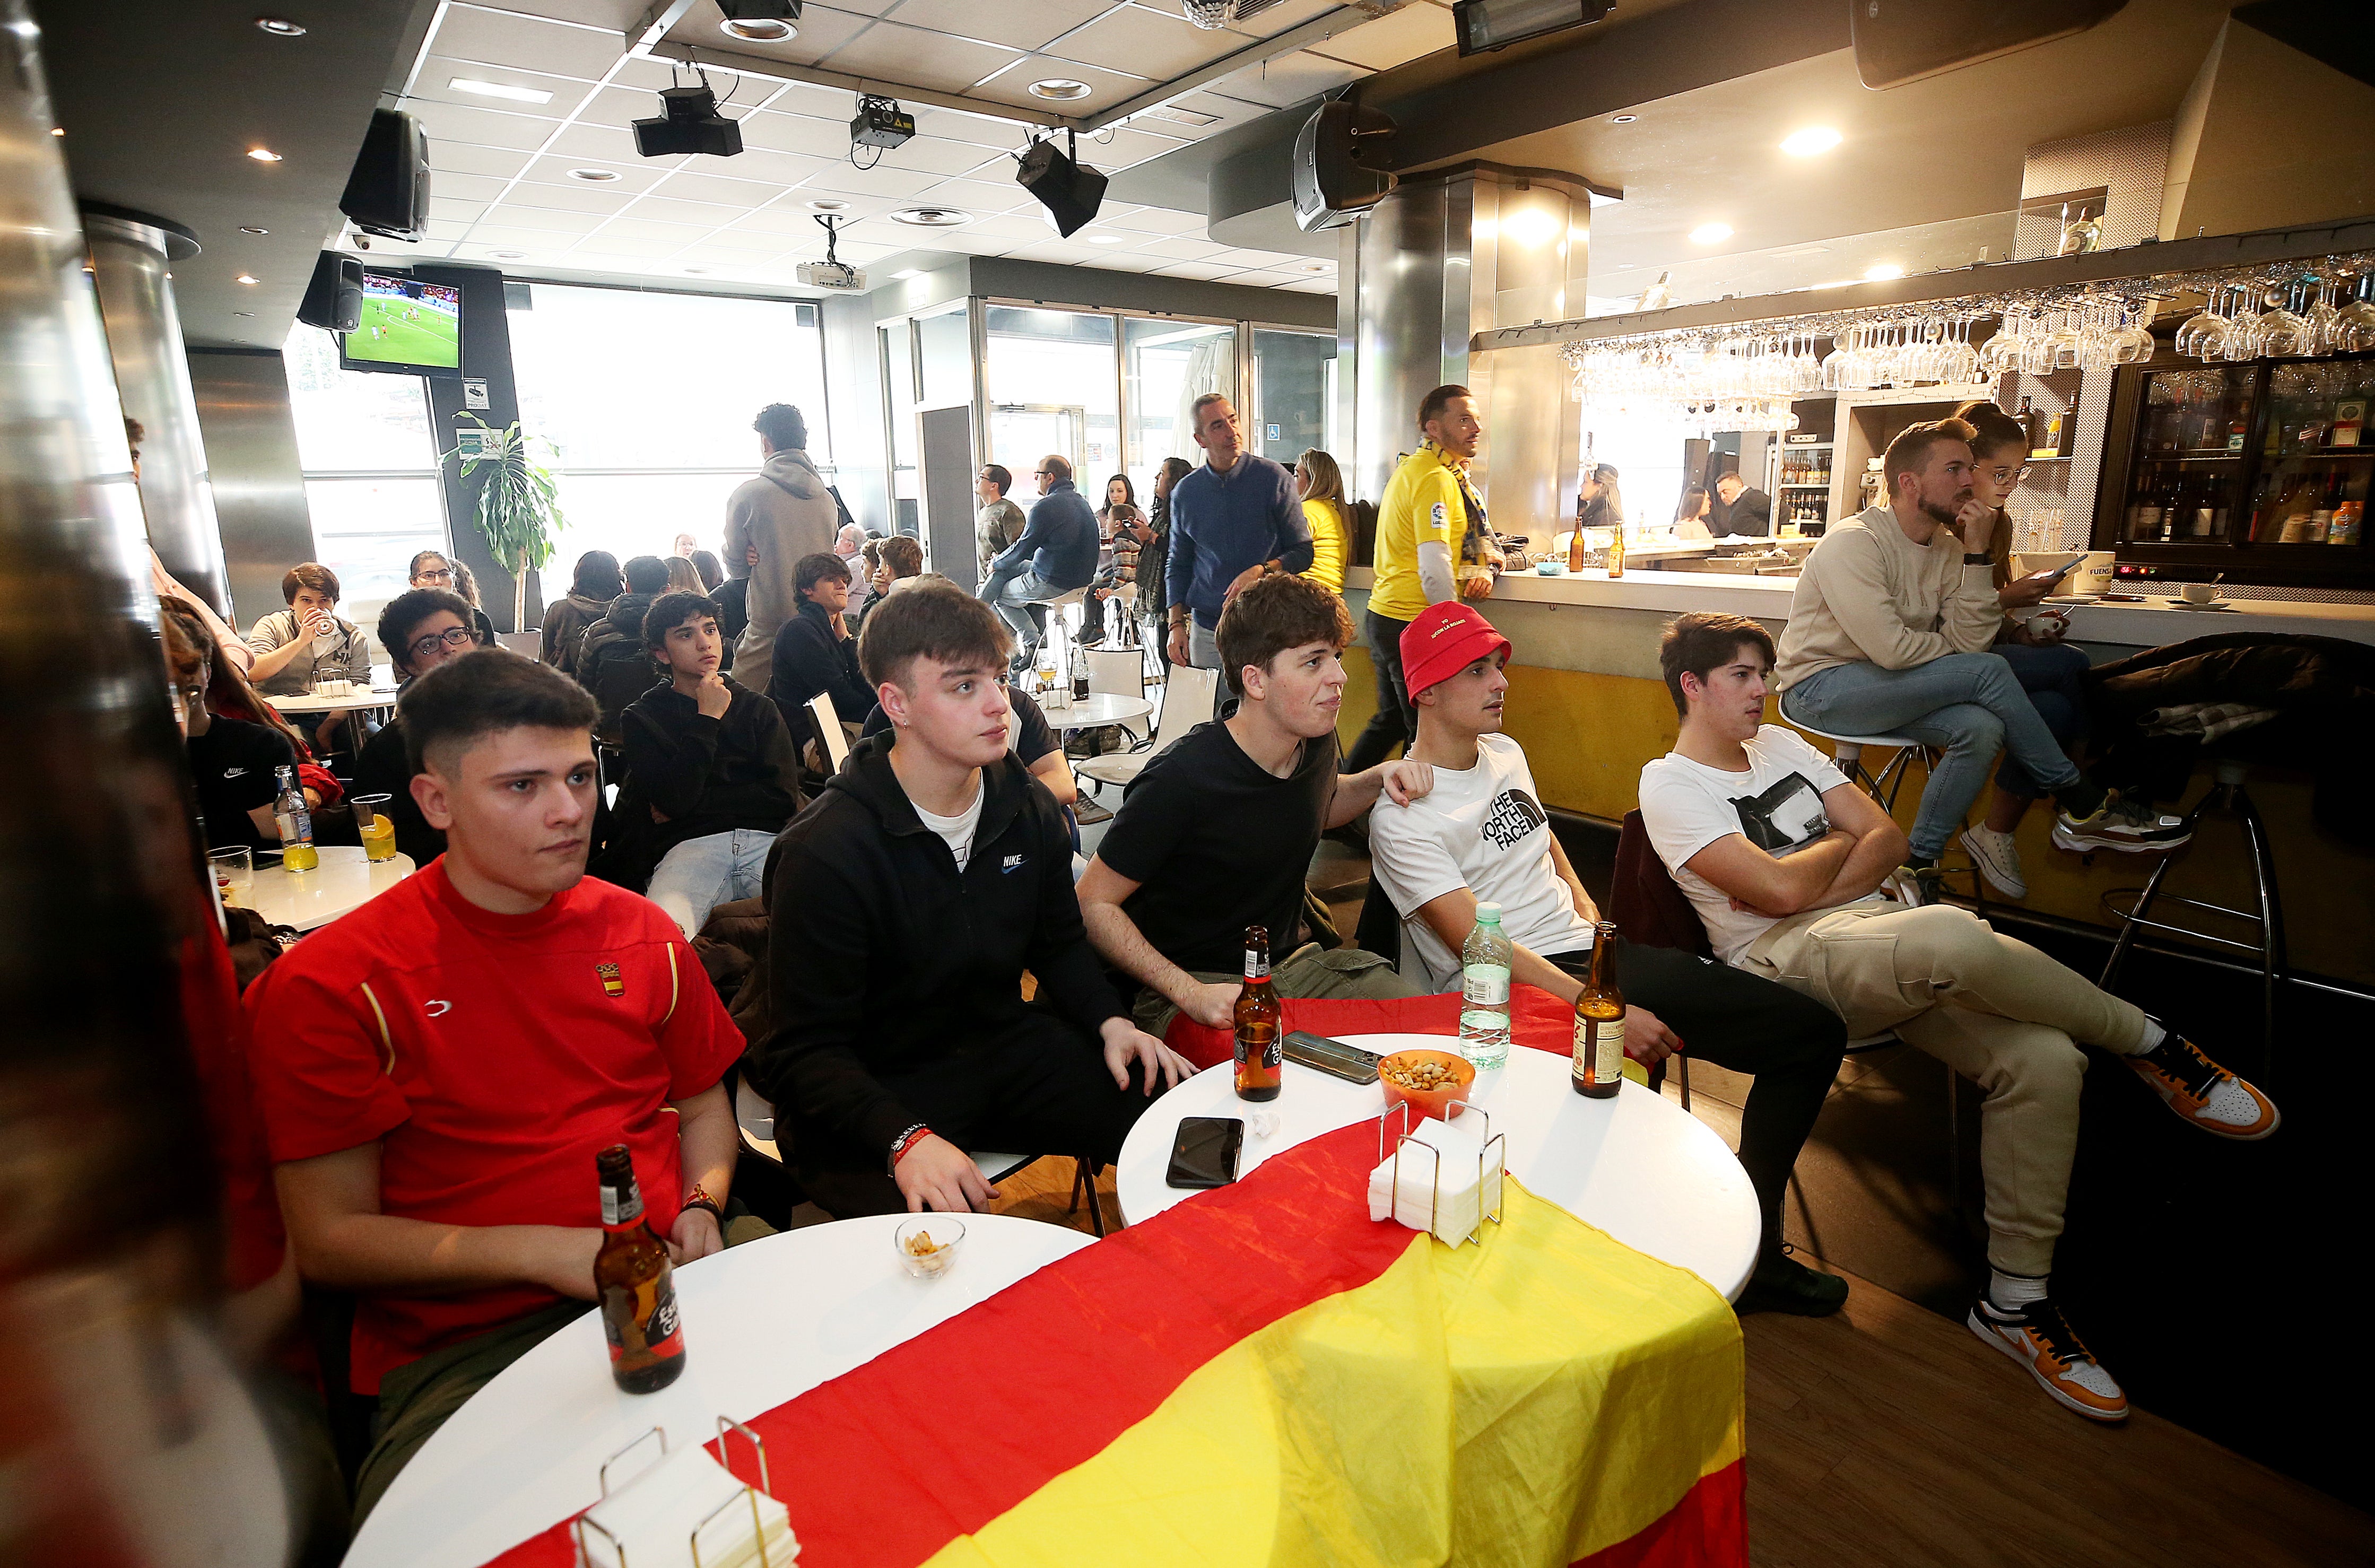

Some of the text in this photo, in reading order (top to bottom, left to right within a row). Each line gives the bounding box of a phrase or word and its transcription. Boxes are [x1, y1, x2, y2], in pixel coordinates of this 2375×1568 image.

[1490, 791, 1513, 817] THE
[1494, 820, 1530, 851] FACE
[1003, 854, 1022, 867] NIKE
